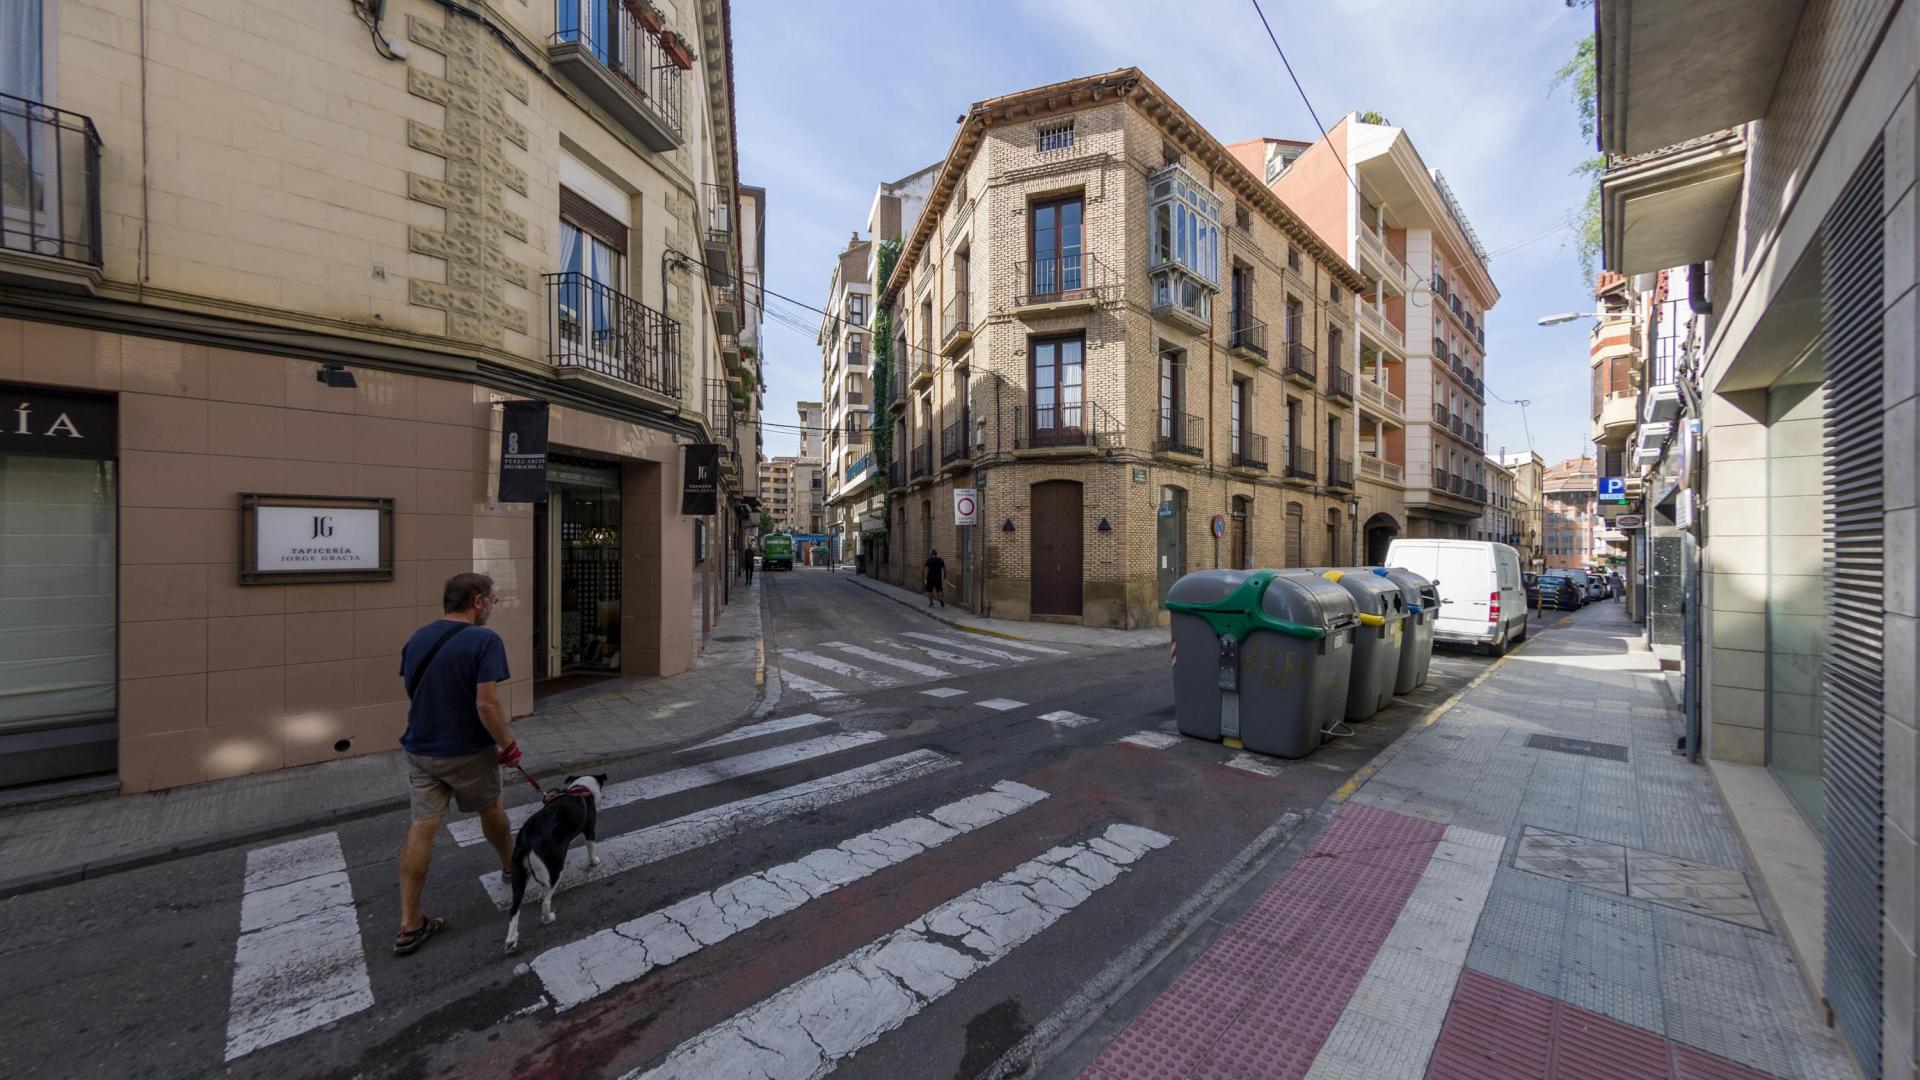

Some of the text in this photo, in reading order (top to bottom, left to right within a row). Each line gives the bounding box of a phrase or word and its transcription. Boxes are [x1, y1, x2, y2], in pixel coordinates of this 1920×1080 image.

[0, 402, 85, 438] ÍA
[1608, 479, 1622, 493] P
[311, 516, 333, 539] JG
